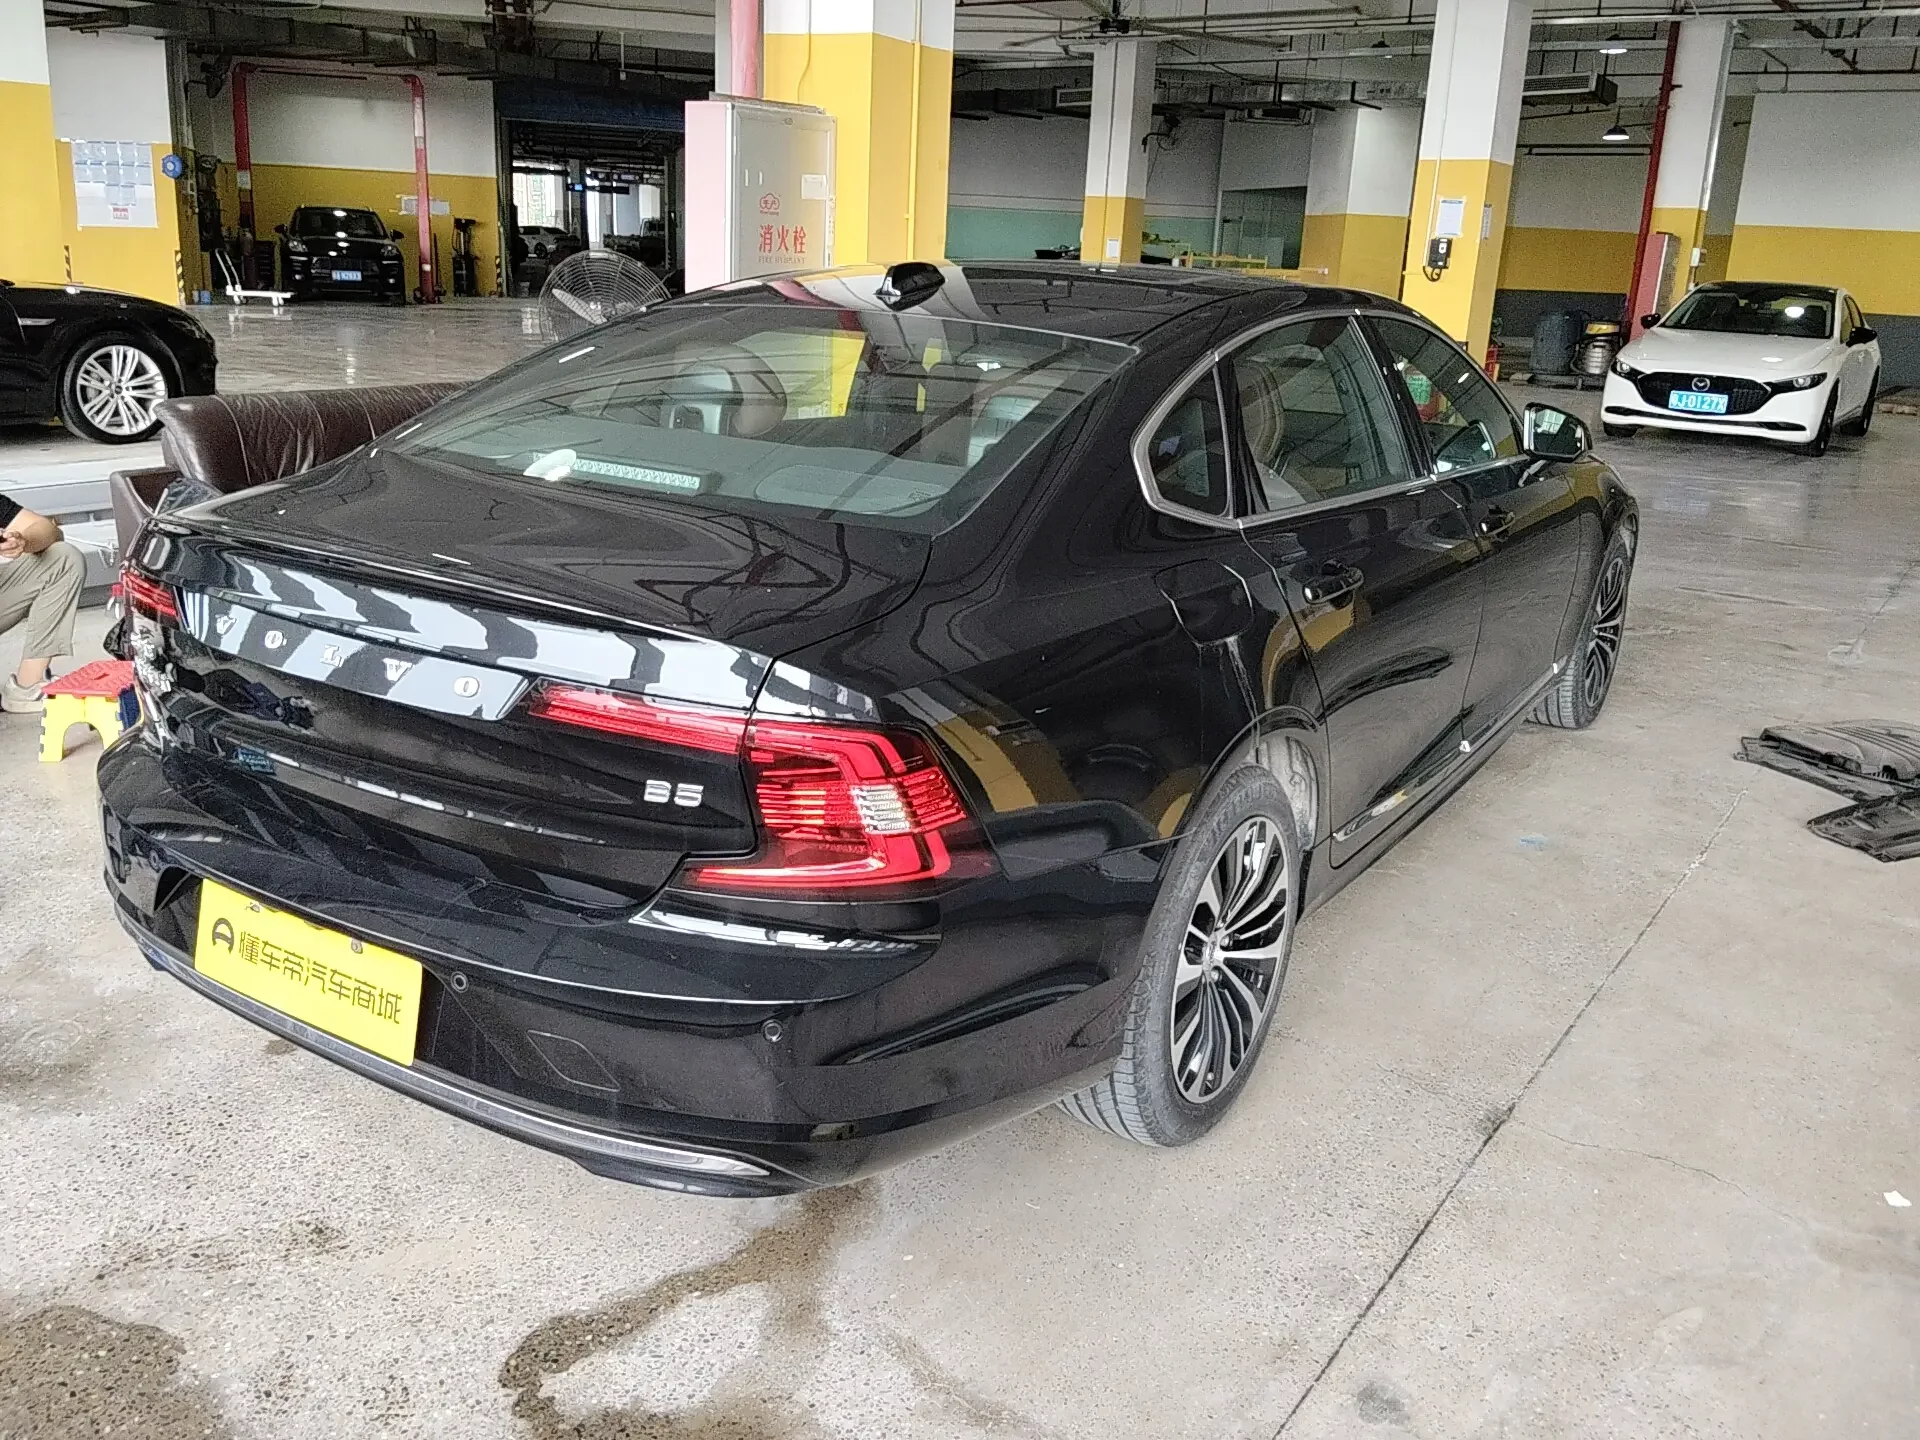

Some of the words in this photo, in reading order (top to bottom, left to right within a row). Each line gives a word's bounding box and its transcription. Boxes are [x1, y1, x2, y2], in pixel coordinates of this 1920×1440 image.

[758, 223, 807, 254] 消火栓
[215, 613, 481, 698] VOLVO
[643, 779, 705, 808] B5
[239, 930, 403, 1025] 懂车帝汽车商城
